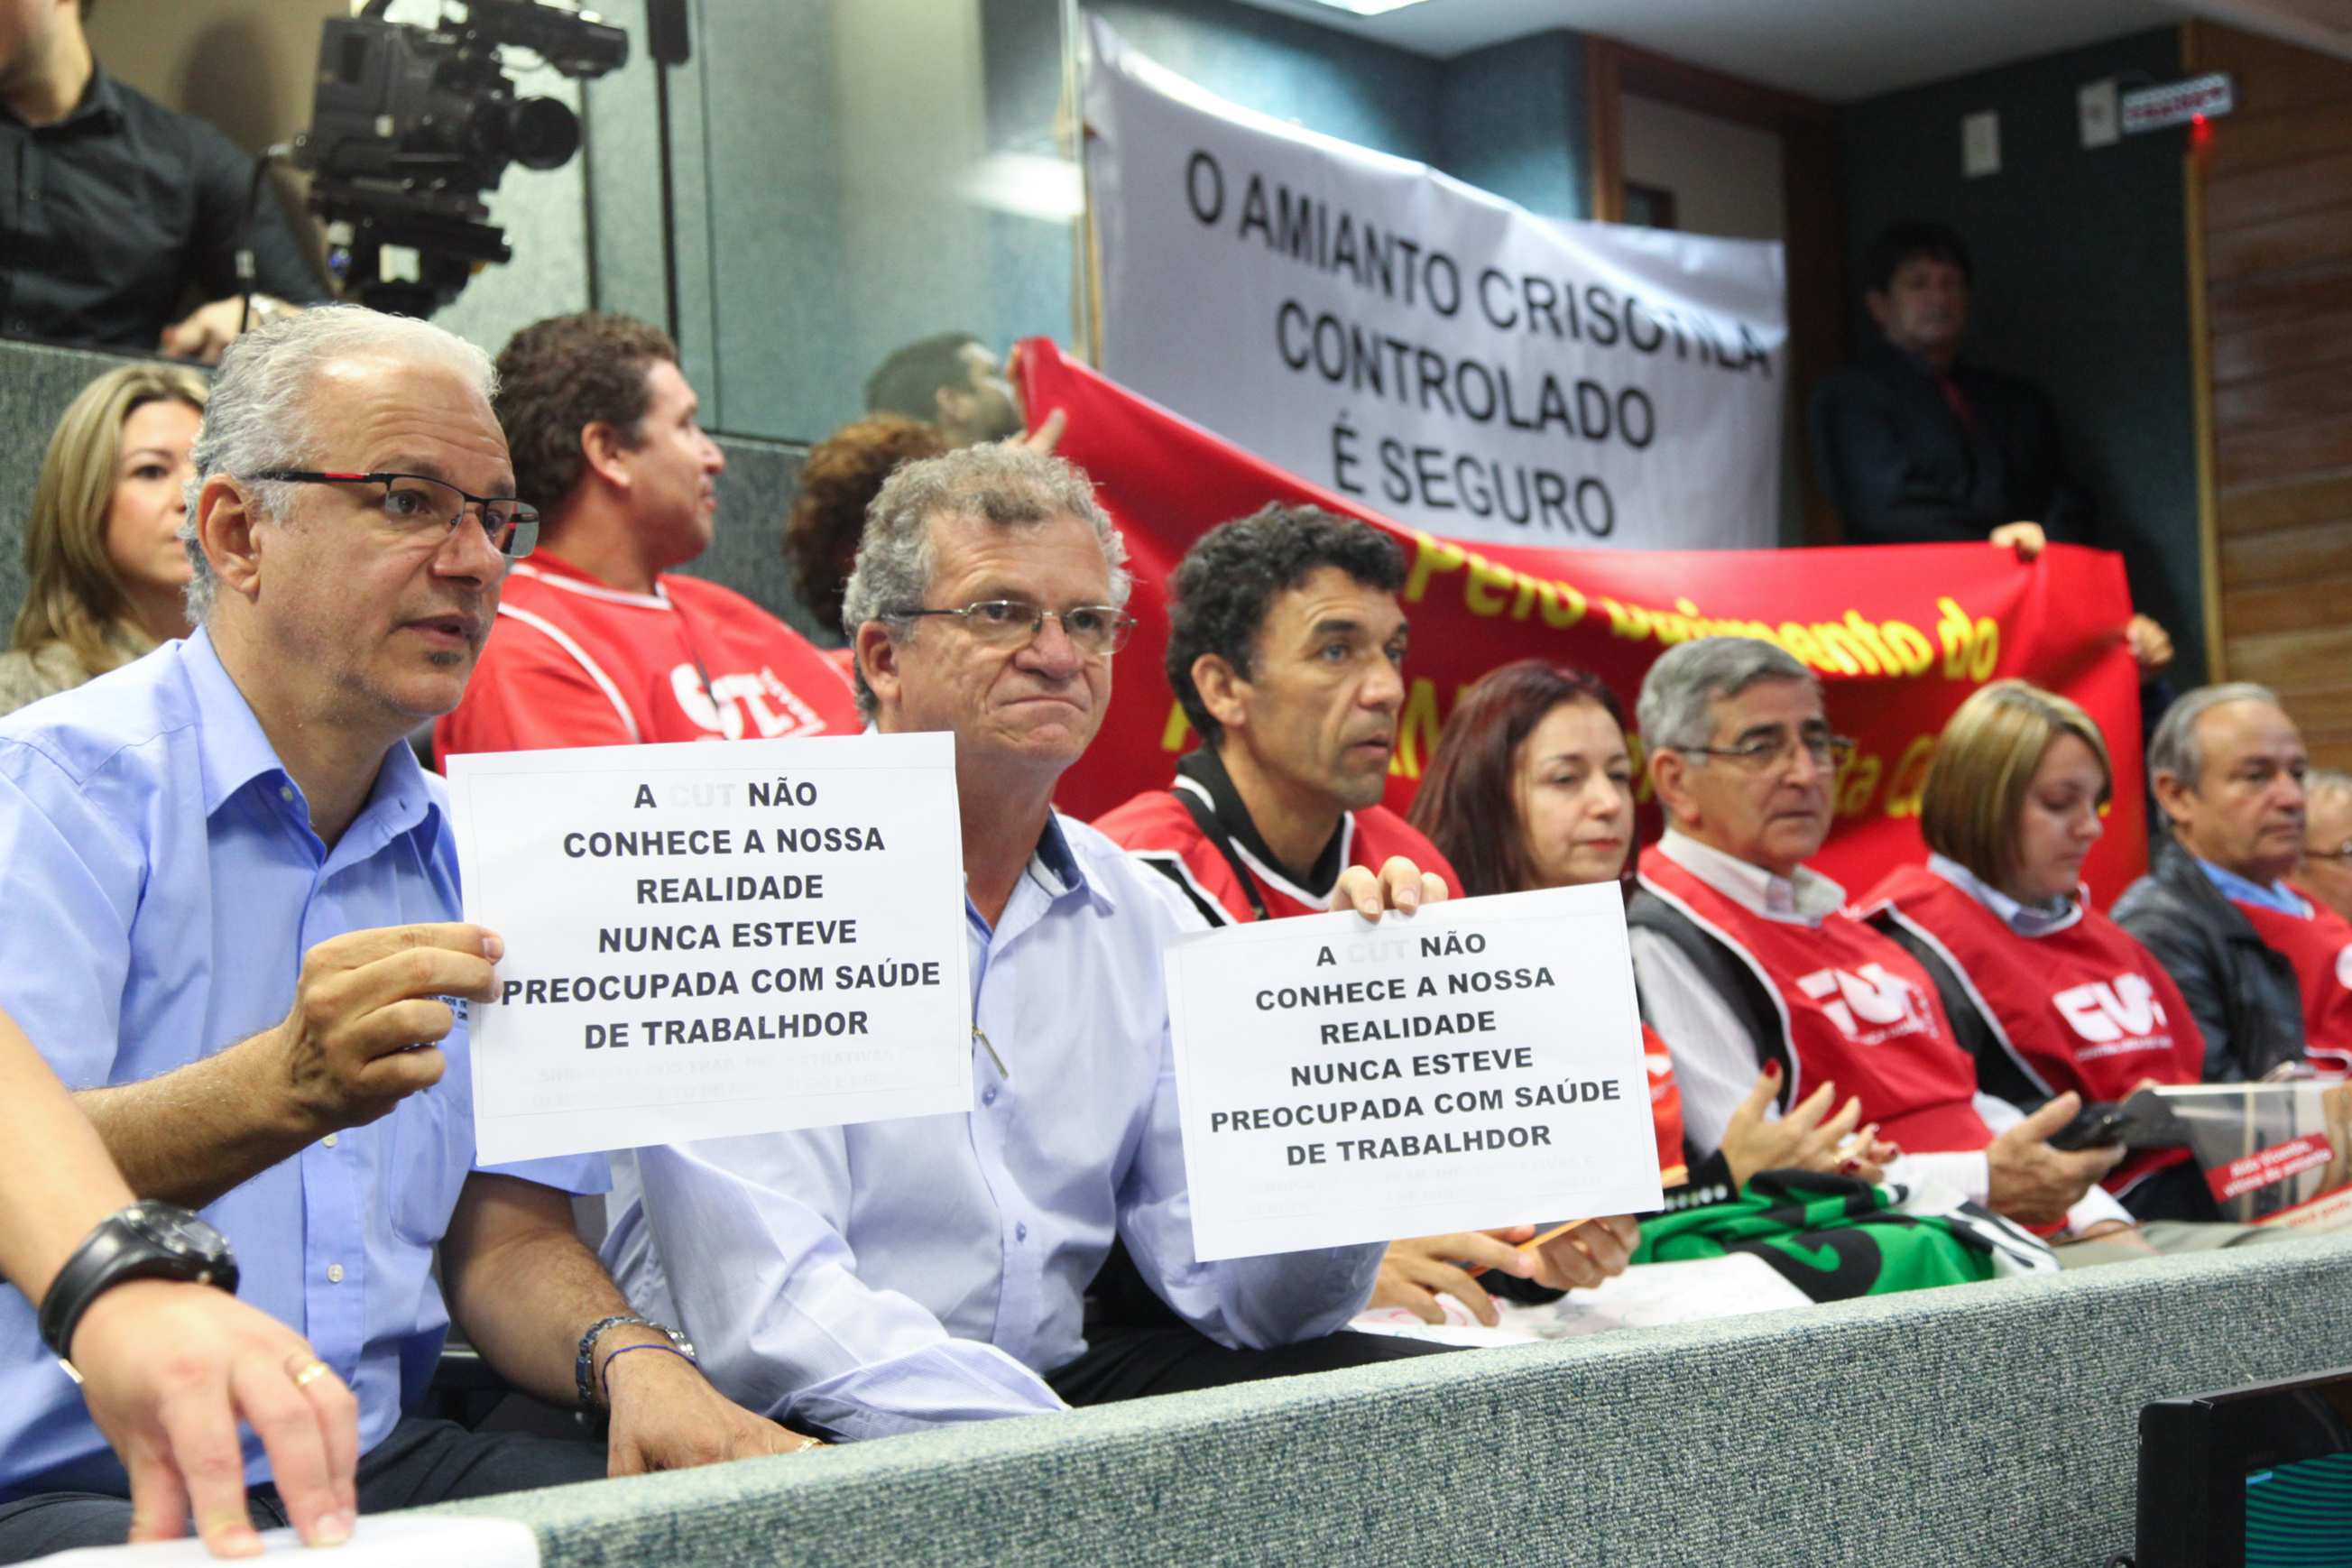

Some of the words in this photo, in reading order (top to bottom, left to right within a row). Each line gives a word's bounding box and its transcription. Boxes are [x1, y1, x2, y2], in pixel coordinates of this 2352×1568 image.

[1184, 148, 1228, 230] O
[1236, 171, 1464, 321] AMIANTO
[1274, 298, 1658, 453] CONTROLADO
[1330, 408, 1366, 495] É
[1379, 437, 1616, 541] SEGURO
[1937, 596, 1999, 682] do
[634, 784, 657, 808] A
[748, 776, 817, 807] NÃO
[563, 829, 733, 858] CONHECE
[743, 829, 765, 853] A
[777, 826, 886, 853] NOSSA
[636, 874, 825, 905] REALIDADE
[598, 924, 722, 954] NUNCA
[732, 919, 858, 948] ESTEVE
[1316, 945, 1337, 967] A
[1420, 930, 1487, 958] NÃO
[502, 971, 741, 1006] PREOCUPADA
[750, 966, 825, 994] COM
[835, 958, 941, 991] SAÚDE
[1255, 978, 1407, 1011] CONHECE
[1416, 976, 1438, 998] A
[1448, 967, 1556, 995] NOSSA
[585, 1022, 630, 1050] DE
[641, 1010, 870, 1047] TRABALHDOR
[1320, 1010, 1498, 1046] REALIDADE
[1291, 1058, 1403, 1088] NUNCA
[1411, 1047, 1534, 1077] ESTEVE
[1211, 1096, 1425, 1133] PREOCUPADA
[1434, 1089, 1504, 1115] COM
[1514, 1078, 1621, 1108] SAÚDE
[1287, 1143, 1327, 1167] DE
[1336, 1124, 1553, 1162] TRABALHDOR
